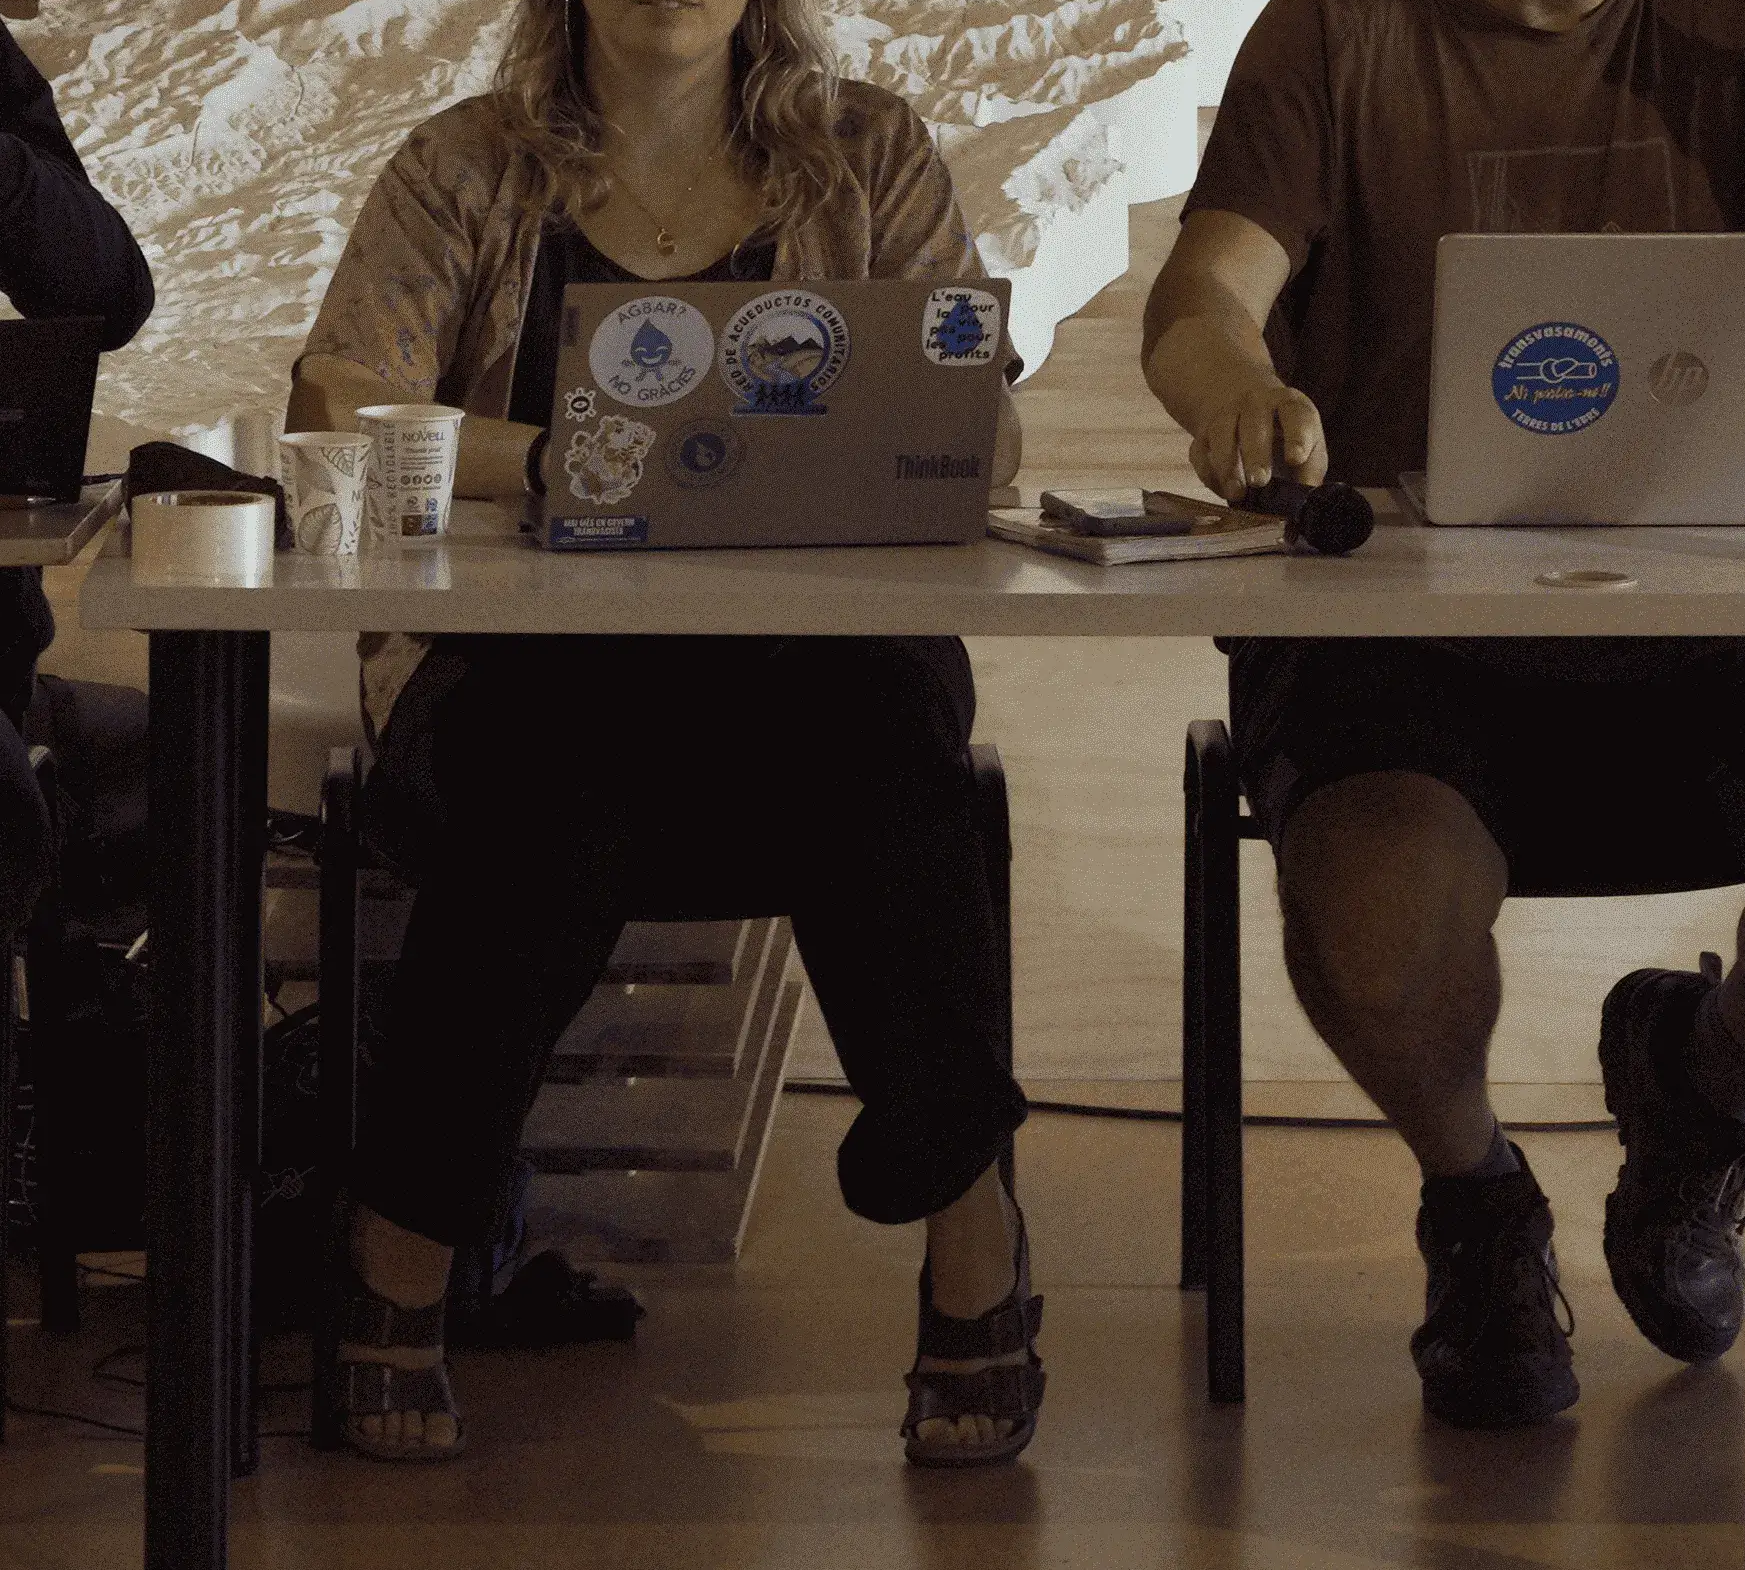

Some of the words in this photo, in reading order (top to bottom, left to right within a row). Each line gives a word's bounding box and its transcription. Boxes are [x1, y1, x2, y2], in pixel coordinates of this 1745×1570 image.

[617, 300, 687, 325] AGBAR?
[728, 295, 812, 342] ACUEDUCTOS
[936, 308, 951, 318] la
[960, 304, 995, 316] pour
[811, 304, 847, 393] COMUNITARIOS
[957, 333, 992, 344] pour
[725, 347, 737, 366] DE
[608, 373, 632, 395] NO
[731, 370, 754, 393] RED
[1511, 409, 1548, 431] TERRES
[1550, 422, 1564, 431] DE
[383, 422, 398, 498] RECYCLABLE
[895, 454, 981, 479] ThinkBook
